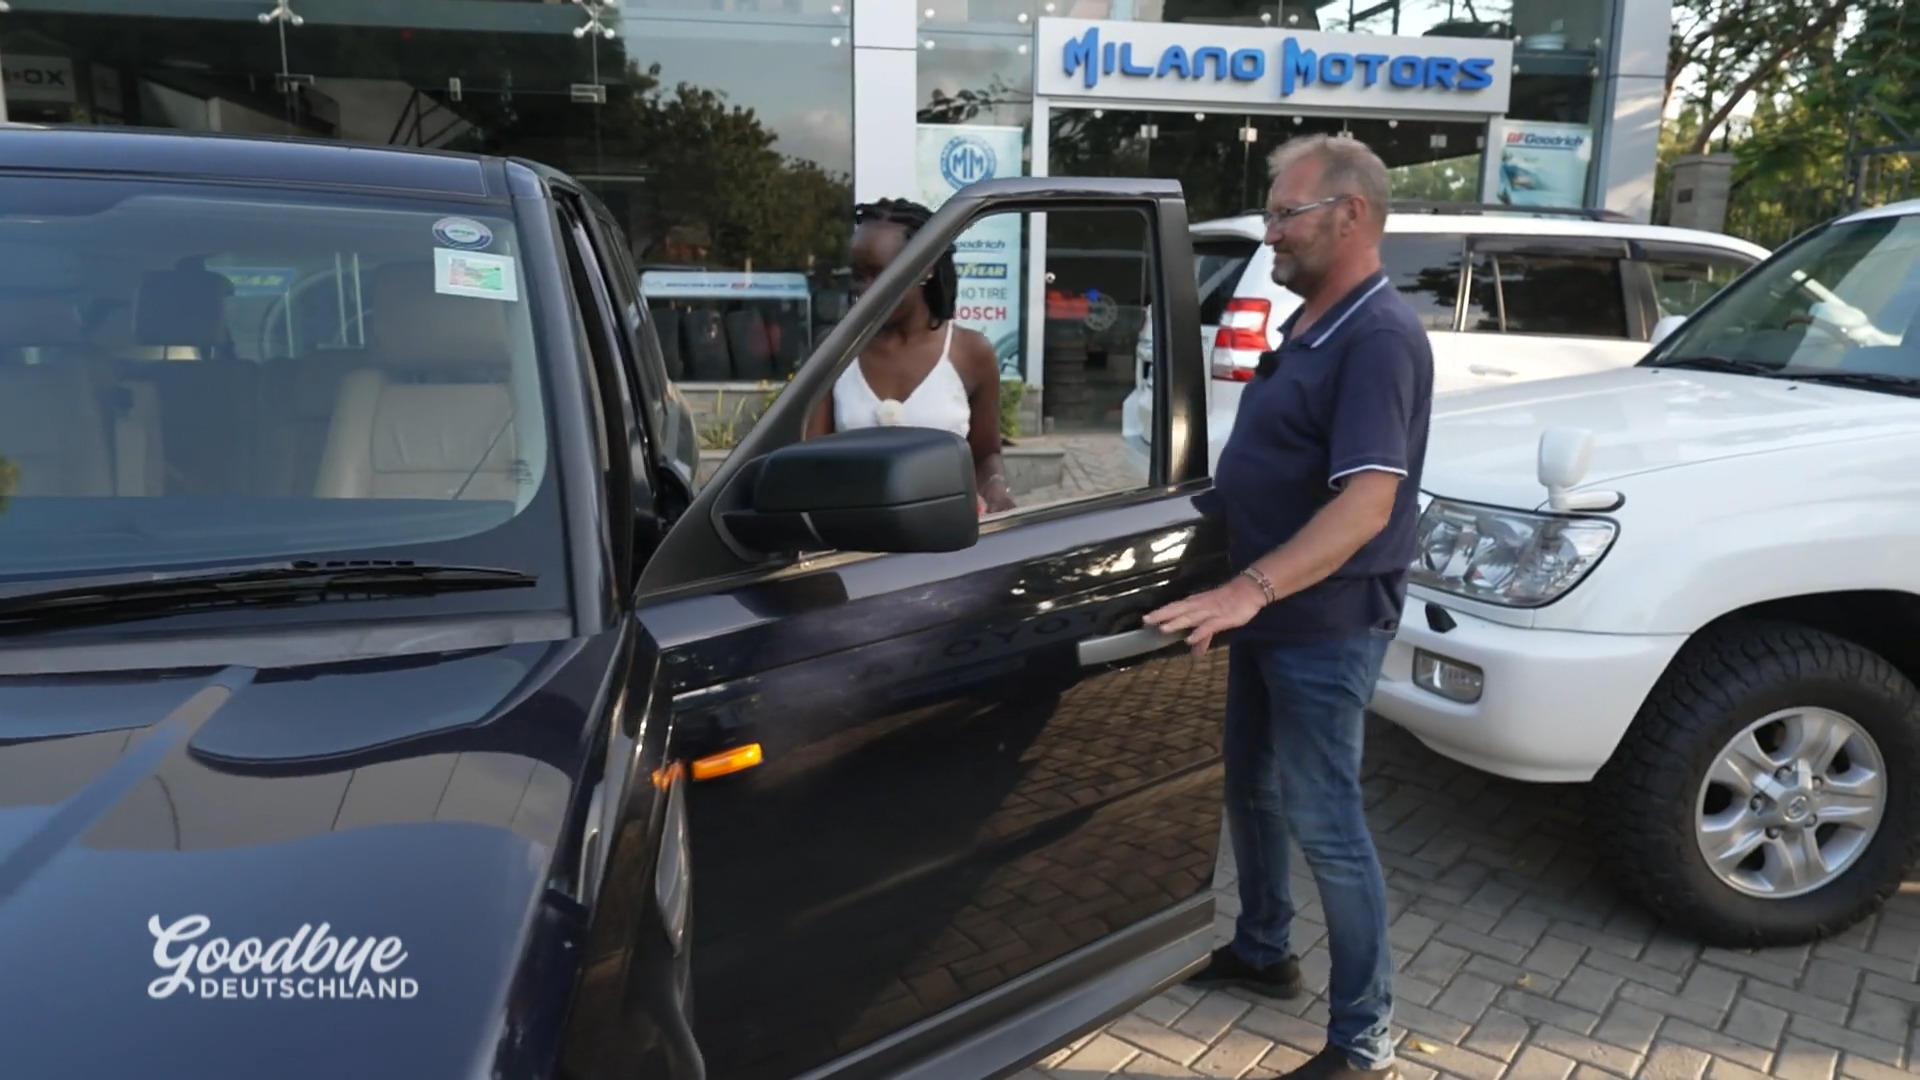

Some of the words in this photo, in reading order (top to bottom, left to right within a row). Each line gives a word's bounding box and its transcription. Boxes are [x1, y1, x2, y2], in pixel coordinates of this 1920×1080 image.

[1280, 36, 1496, 97] MOTORS
[952, 146, 985, 180] MM
[956, 239, 1006, 249] oodrich
[979, 287, 1008, 300] TIRE
